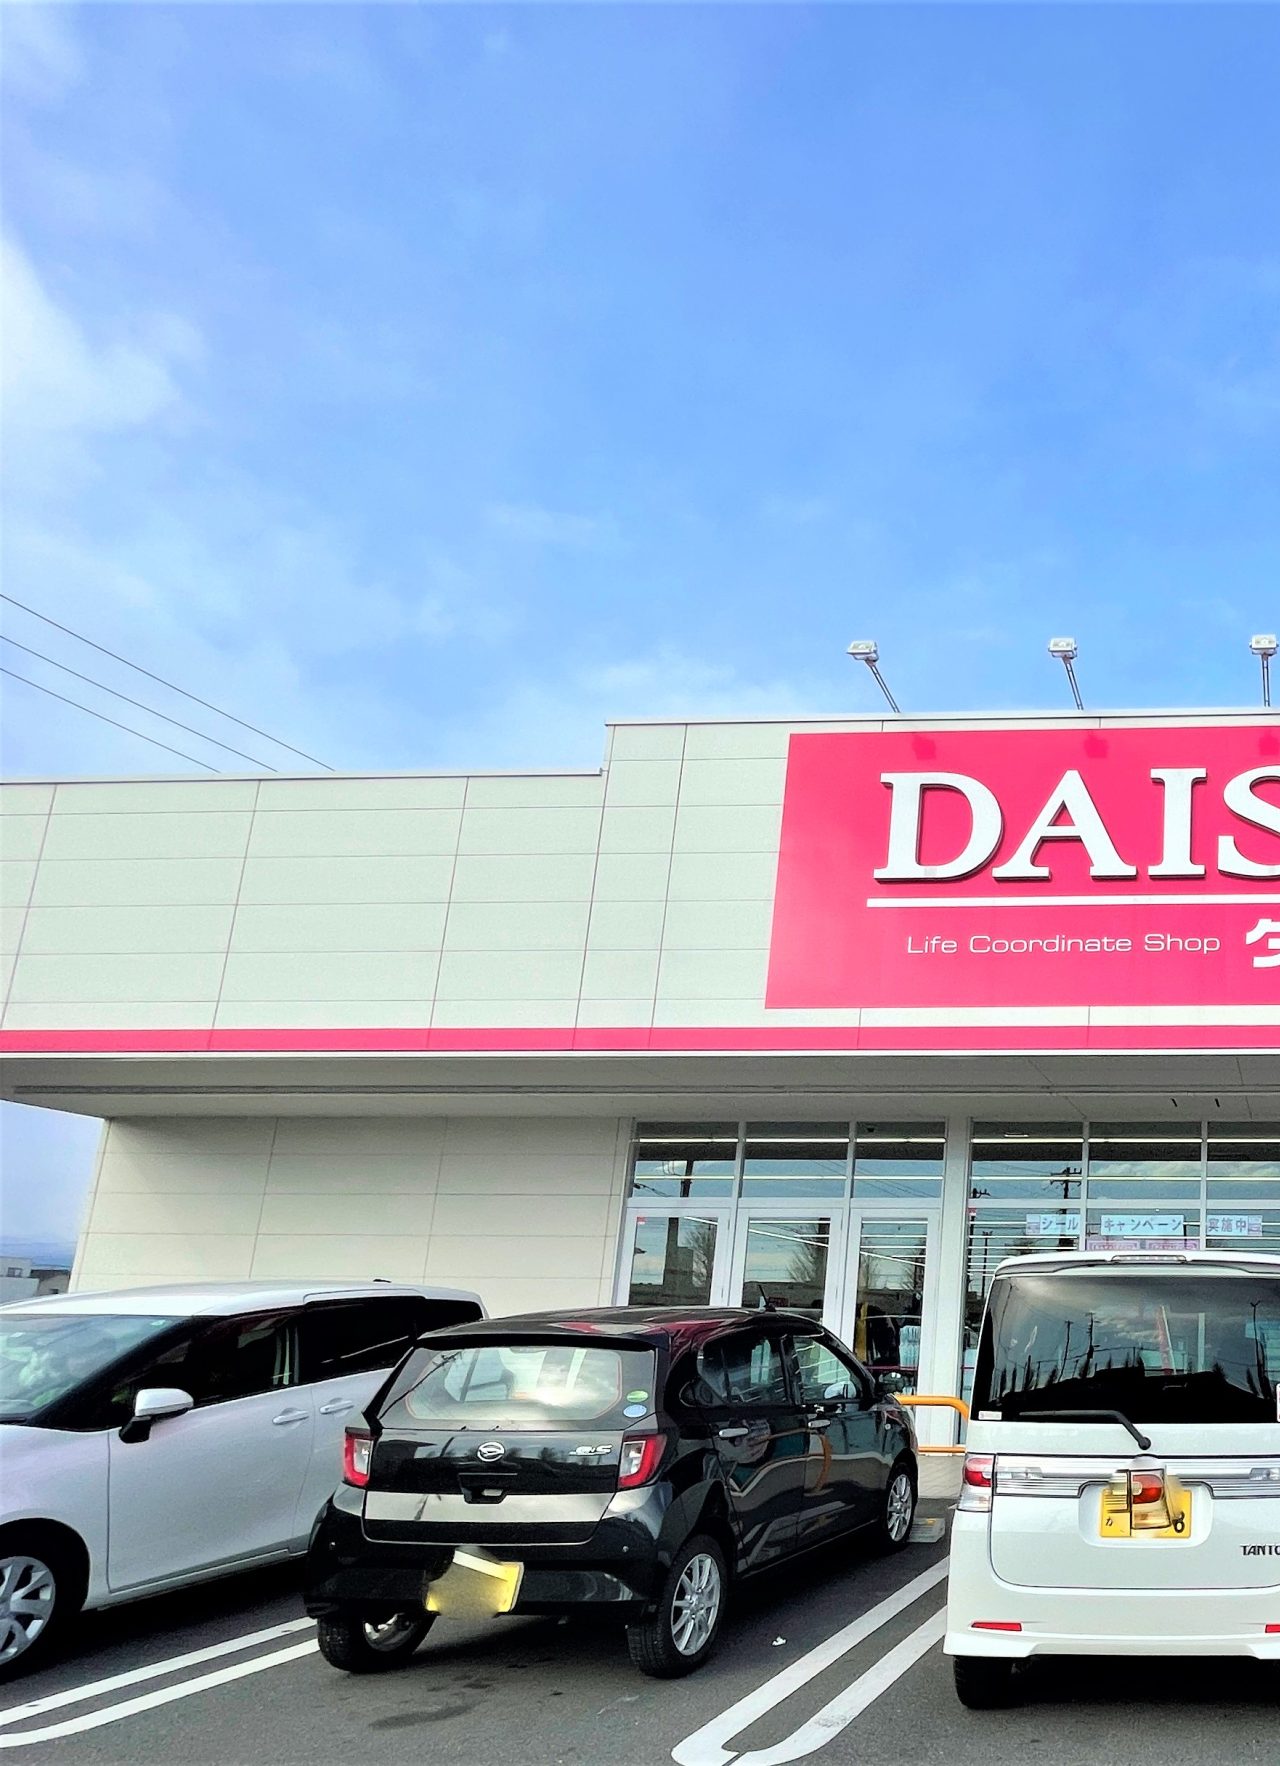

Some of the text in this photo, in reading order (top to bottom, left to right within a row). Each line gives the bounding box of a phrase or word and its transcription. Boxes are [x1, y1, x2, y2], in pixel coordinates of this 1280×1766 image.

[906, 933, 1221, 955] Life Coordinate Shop
[1041, 1215, 1248, 1233] シール キャンペーン 実施中
